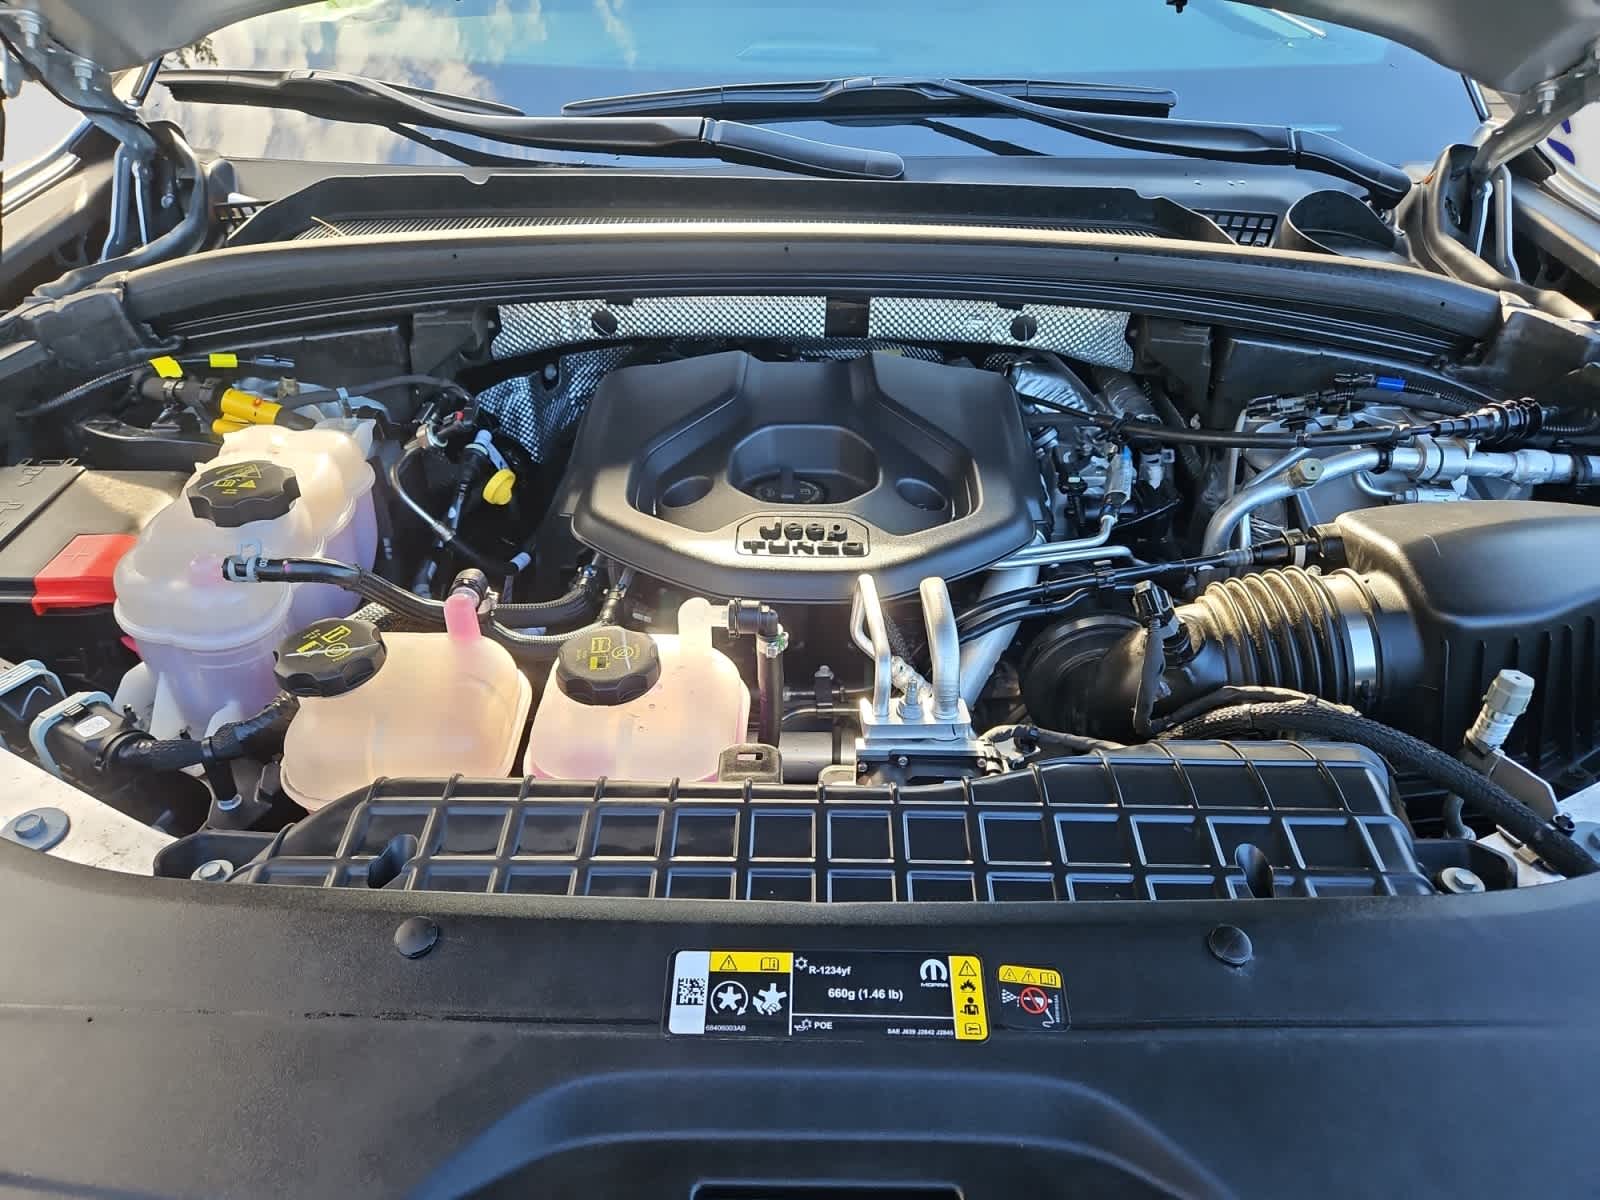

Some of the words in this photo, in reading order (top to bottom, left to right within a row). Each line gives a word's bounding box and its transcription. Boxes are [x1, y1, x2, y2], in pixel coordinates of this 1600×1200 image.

[808, 966, 852, 976] R-1234yf
[827, 988, 856, 1001] 660g
[858, 988, 886, 1001] (1.46
[888, 989, 903, 1002] lb)
[813, 1021, 833, 1030] POE
